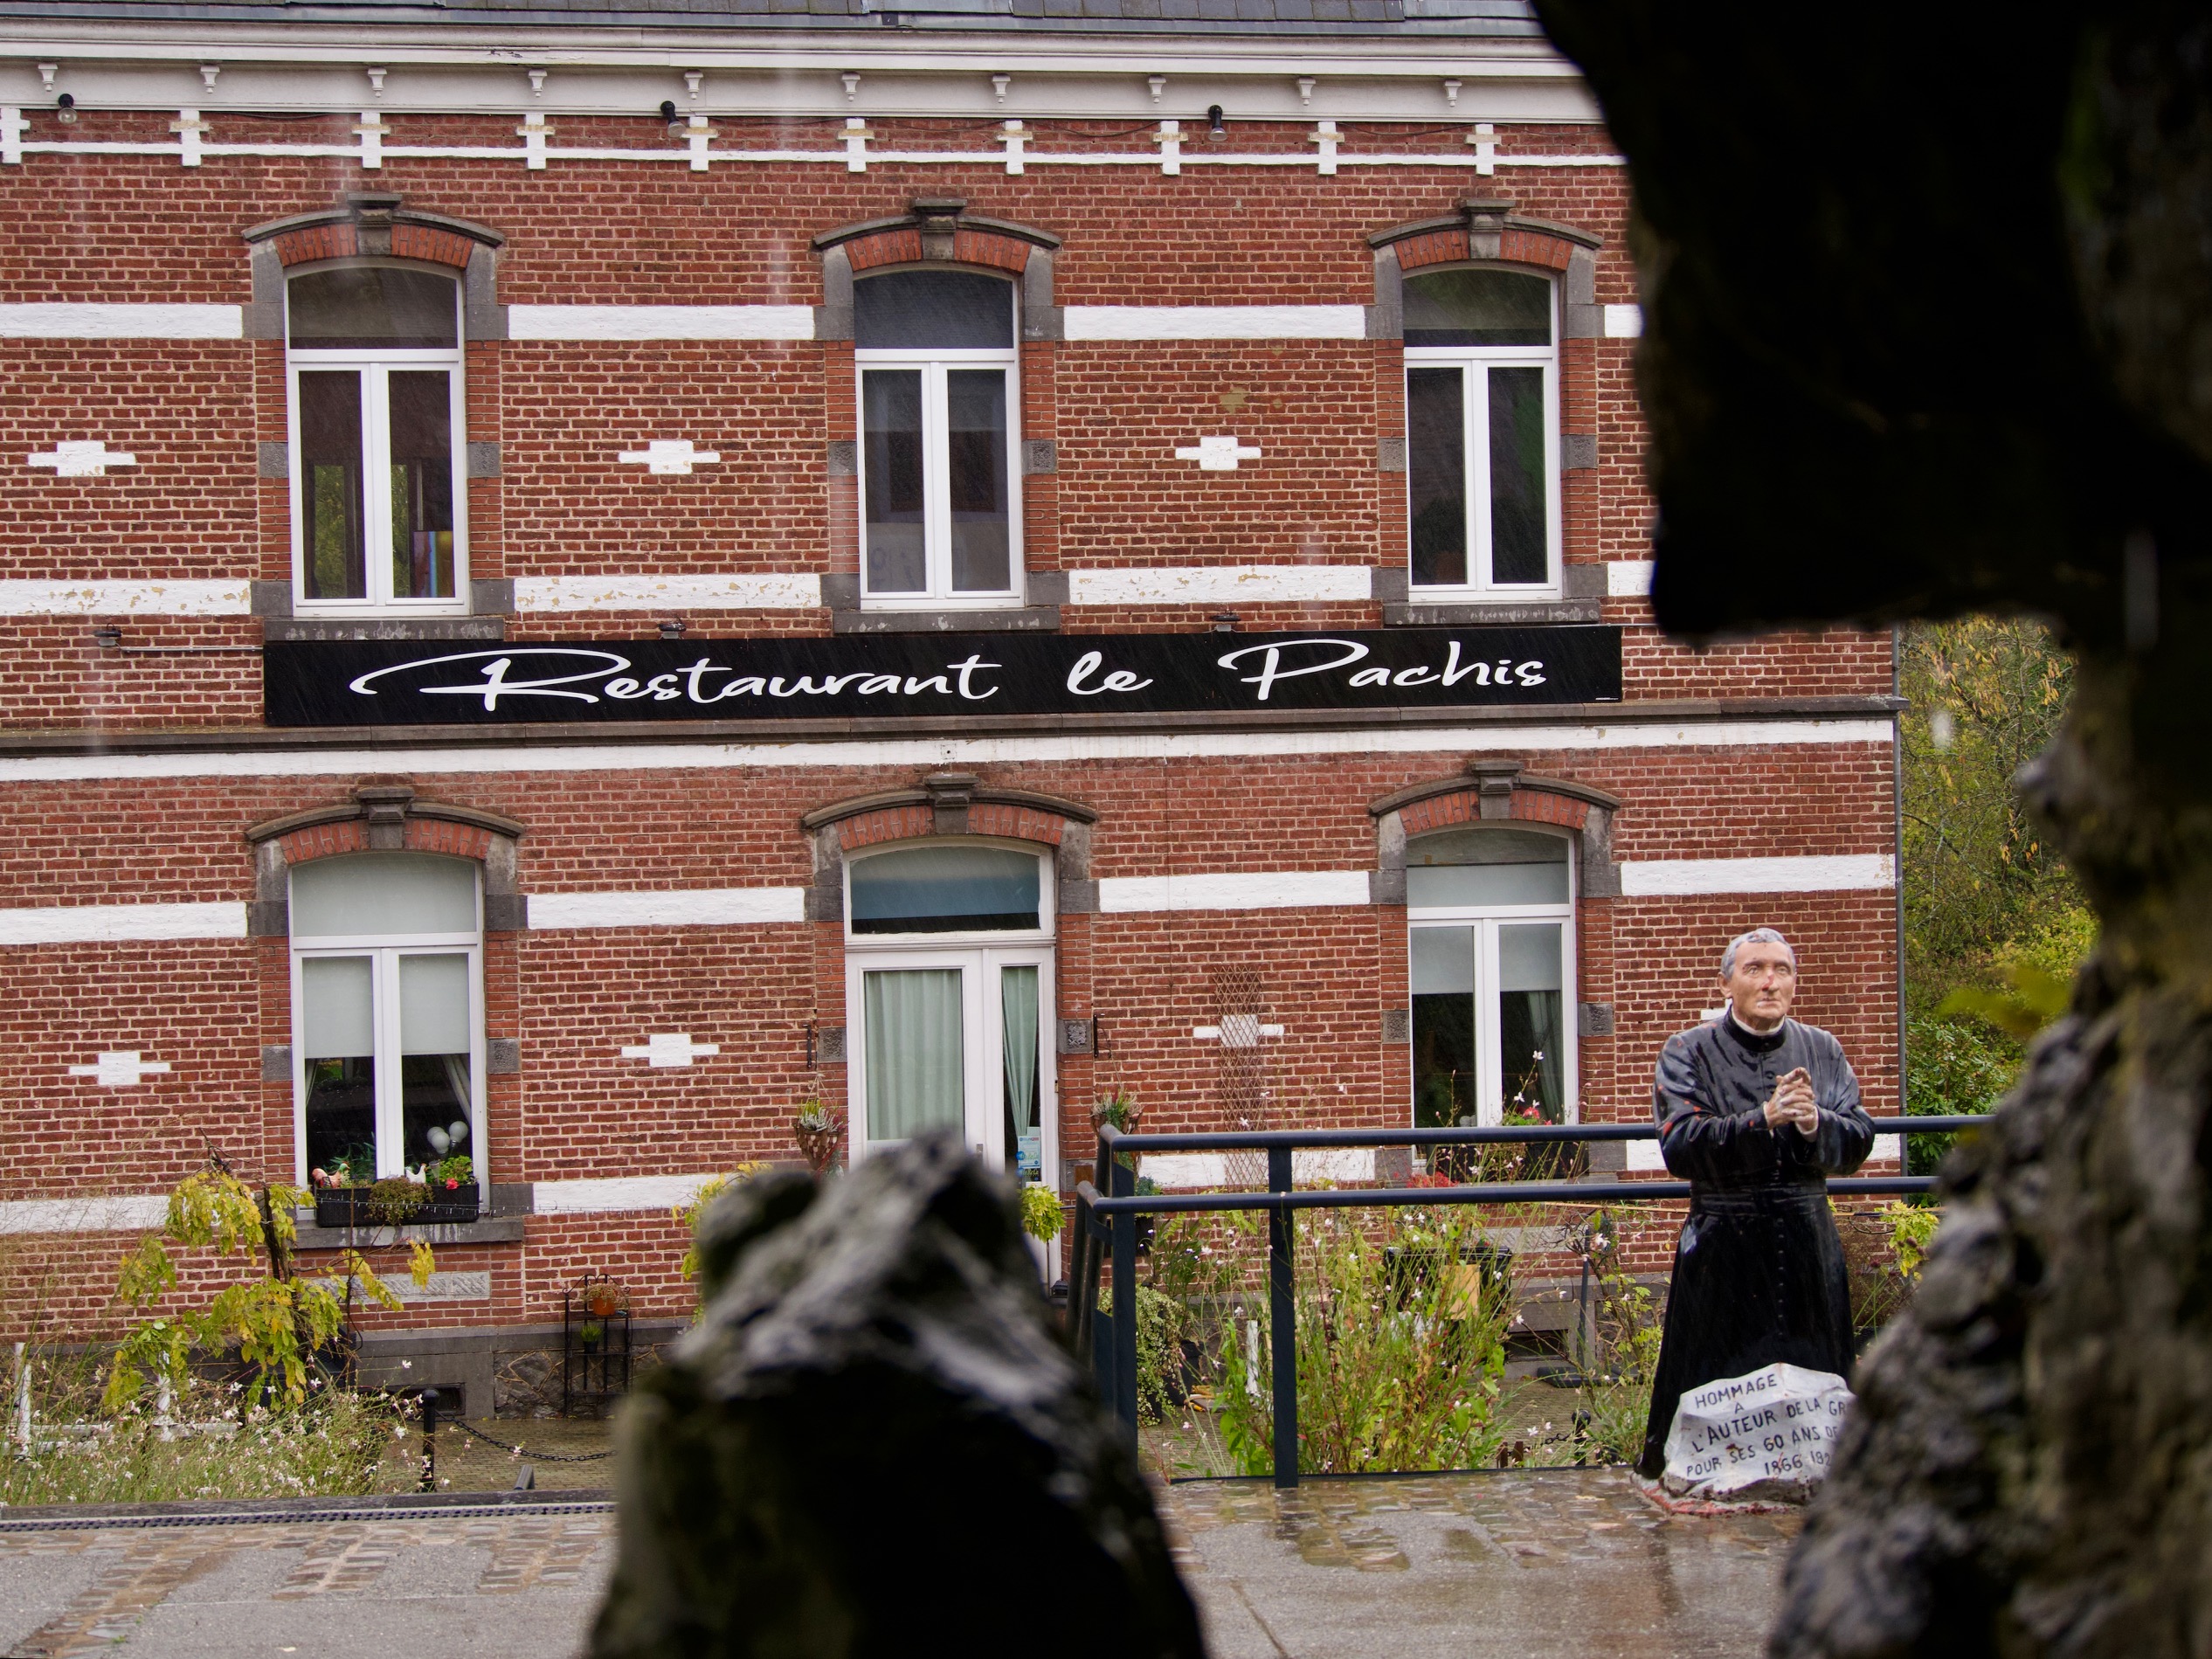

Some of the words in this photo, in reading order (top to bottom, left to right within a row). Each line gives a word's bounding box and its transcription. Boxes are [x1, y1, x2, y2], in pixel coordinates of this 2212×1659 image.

[349, 648, 1002, 712] Restaurant
[1067, 651, 1154, 695] le
[1217, 638, 1547, 700] Pachis
[1695, 1373, 1778, 1409] HOMMAGE
[1734, 1402, 1745, 1414] A
[1686, 1457, 1722, 1477] POUR
[1731, 1447, 1756, 1463] SES
[1763, 1434, 1785, 1452] 60
[1792, 1426, 1821, 1446] ANS
[1692, 1409, 1778, 1455] L'AUTEUR
[1765, 1454, 1803, 1476] 1866
